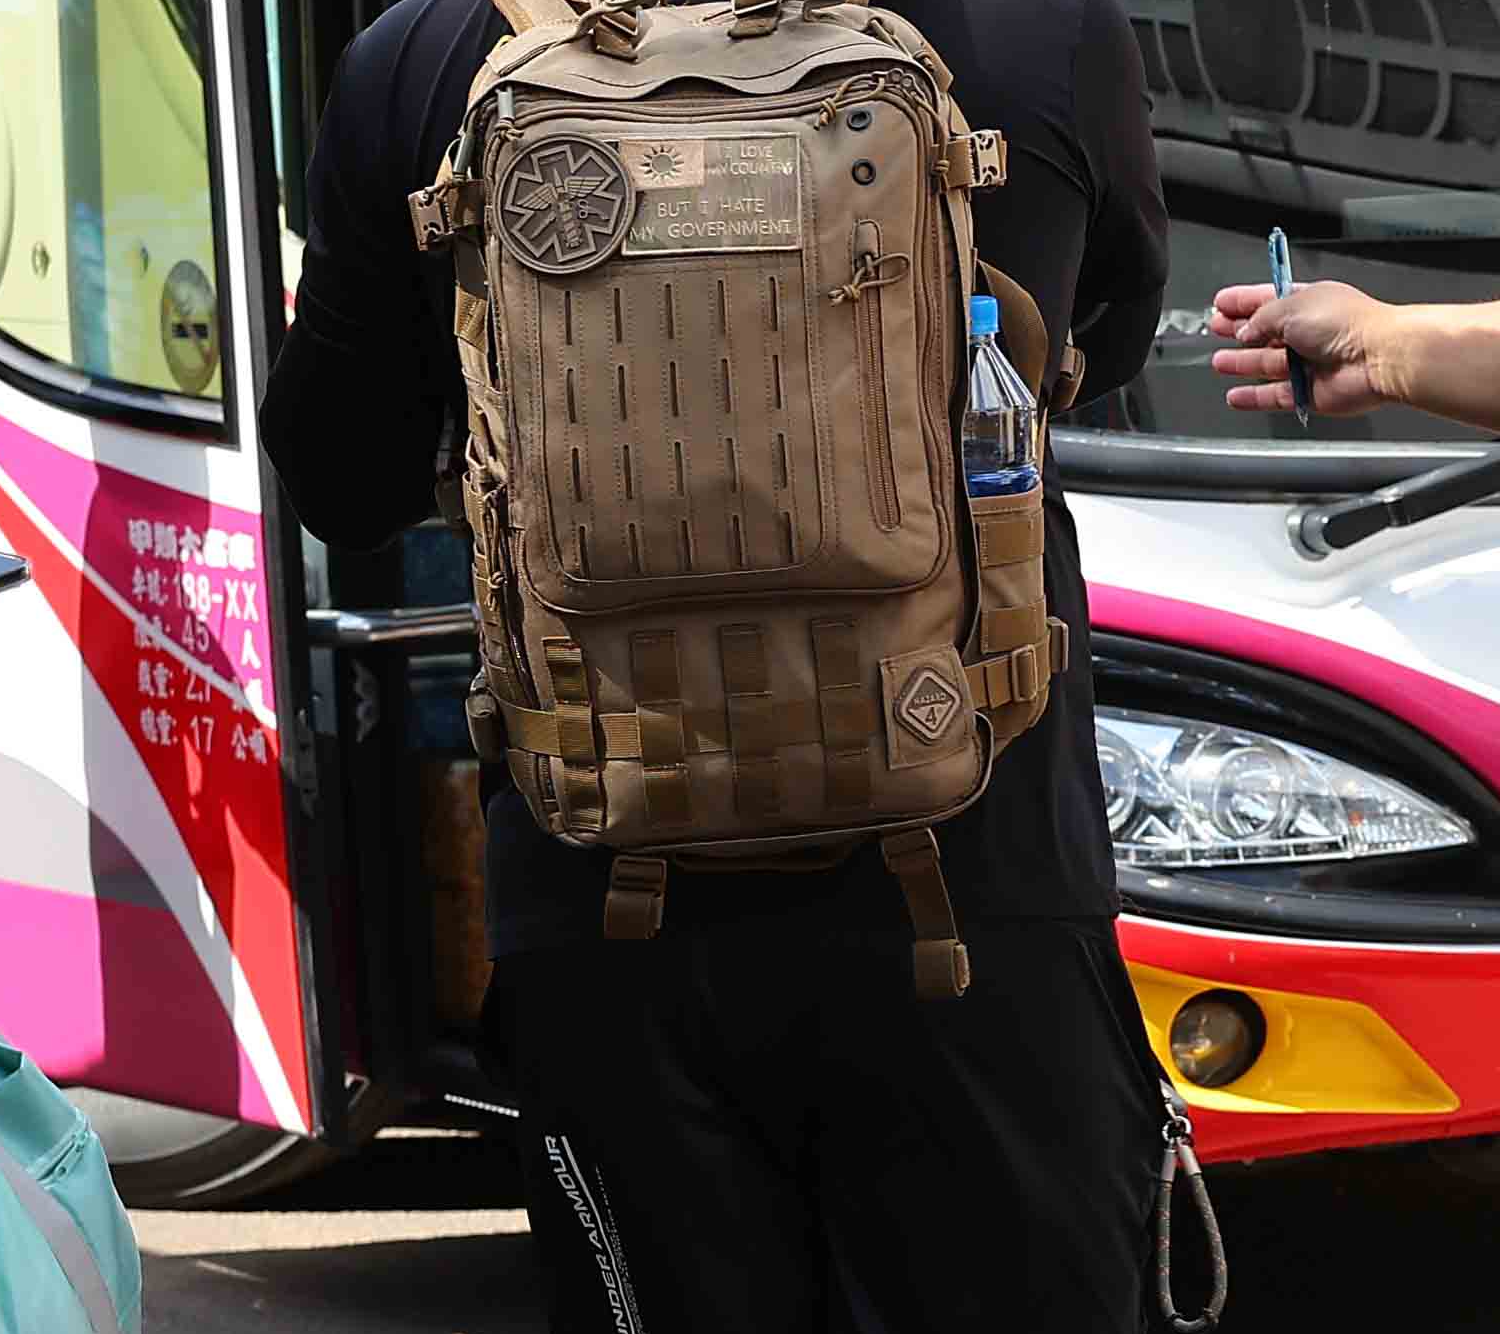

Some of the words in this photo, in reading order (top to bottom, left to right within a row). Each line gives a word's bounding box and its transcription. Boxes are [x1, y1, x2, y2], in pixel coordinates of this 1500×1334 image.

[740, 145, 773, 160] LOVE
[657, 200, 692, 217] BUT
[721, 197, 765, 214] HATE
[629, 226, 657, 244] MY
[667, 219, 793, 239] GOVERNMENT
[182, 615, 211, 652] 45
[241, 628, 261, 669] 人
[925, 707, 937, 725] 4
[190, 715, 215, 755] 17
[544, 1135, 604, 1250] ARMOUR
